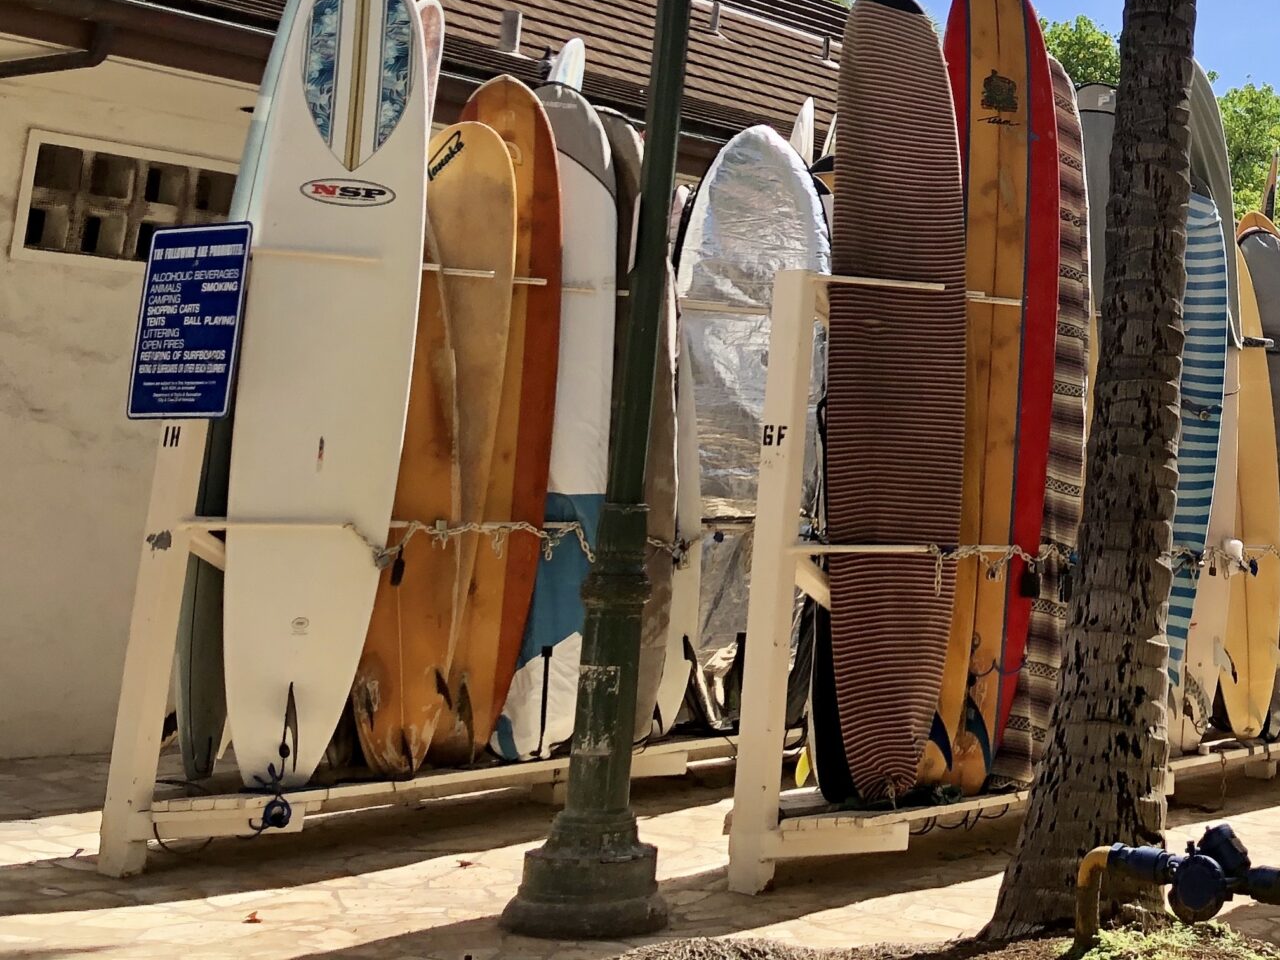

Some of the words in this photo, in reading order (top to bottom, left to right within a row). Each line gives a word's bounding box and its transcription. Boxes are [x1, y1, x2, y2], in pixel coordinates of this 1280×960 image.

[312, 184, 386, 198] NSP
[152, 271, 193, 282] ALCOHOLIC
[194, 269, 239, 279] BEVERAGES
[150, 283, 182, 293] ANIMALS
[201, 281, 238, 292] SMOKING
[148, 294, 181, 305] CAMPING
[147, 305, 178, 315] SHOPPING
[179, 304, 200, 314] CARTS
[147, 317, 166, 326] TENTS
[183, 316, 201, 325] BALL
[204, 315, 236, 325] PLAYING
[143, 328, 180, 338] LITTERING
[141, 340, 162, 350] OPEN
[163, 339, 185, 348] FIRES
[172, 351, 182, 360] OF
